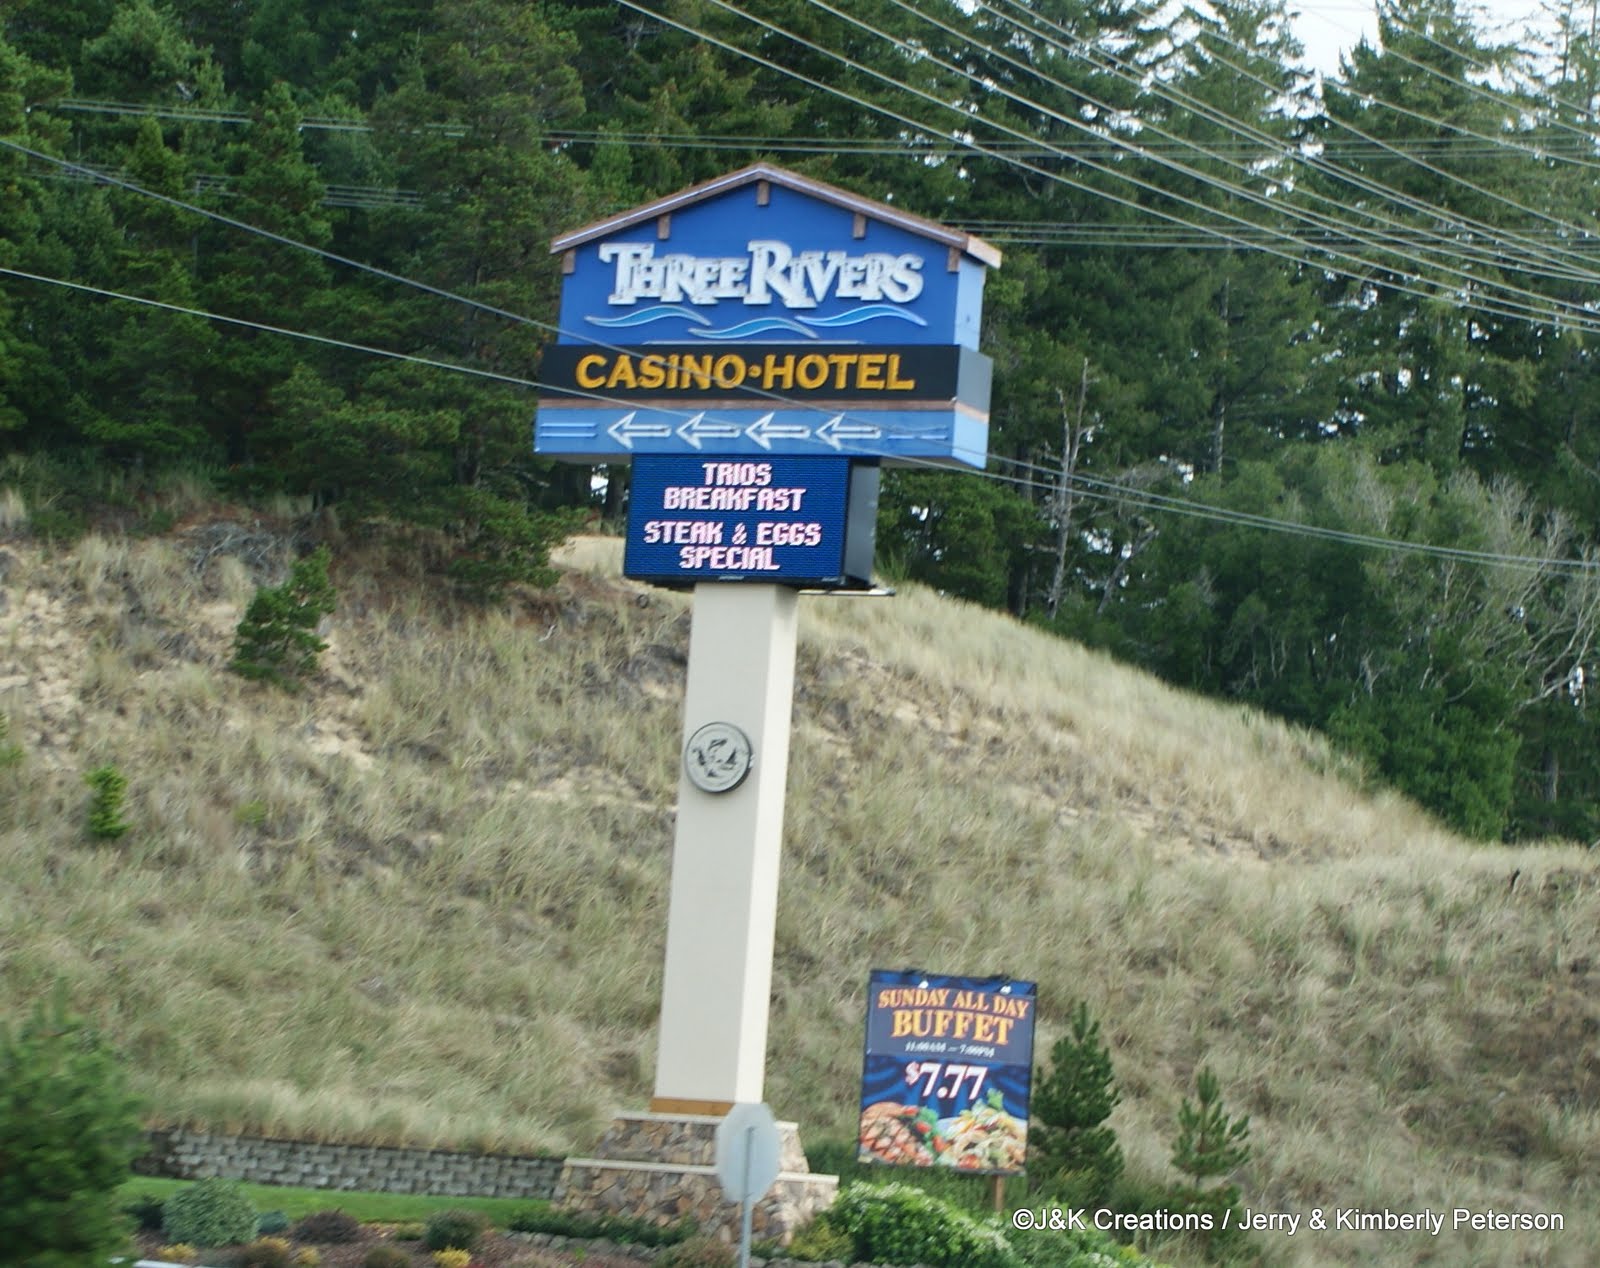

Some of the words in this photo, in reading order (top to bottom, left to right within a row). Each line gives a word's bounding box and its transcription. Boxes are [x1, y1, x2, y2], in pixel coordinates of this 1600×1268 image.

[599, 242, 749, 305] THREE
[743, 240, 924, 308] RIVERS
[702, 463, 773, 486] TRIOS
[662, 486, 807, 511] BREAKFAST
[643, 521, 724, 544] STEAK
[731, 522, 748, 545] &
[756, 522, 822, 546] EGGS
[679, 546, 781, 570] SPECIAL
[878, 988, 950, 1008] SUNDAY
[952, 990, 990, 1011] ALL
[993, 995, 1029, 1019] DAY
[892, 1009, 1014, 1045] BUFFET
[905, 1060, 988, 1100] $7.77
